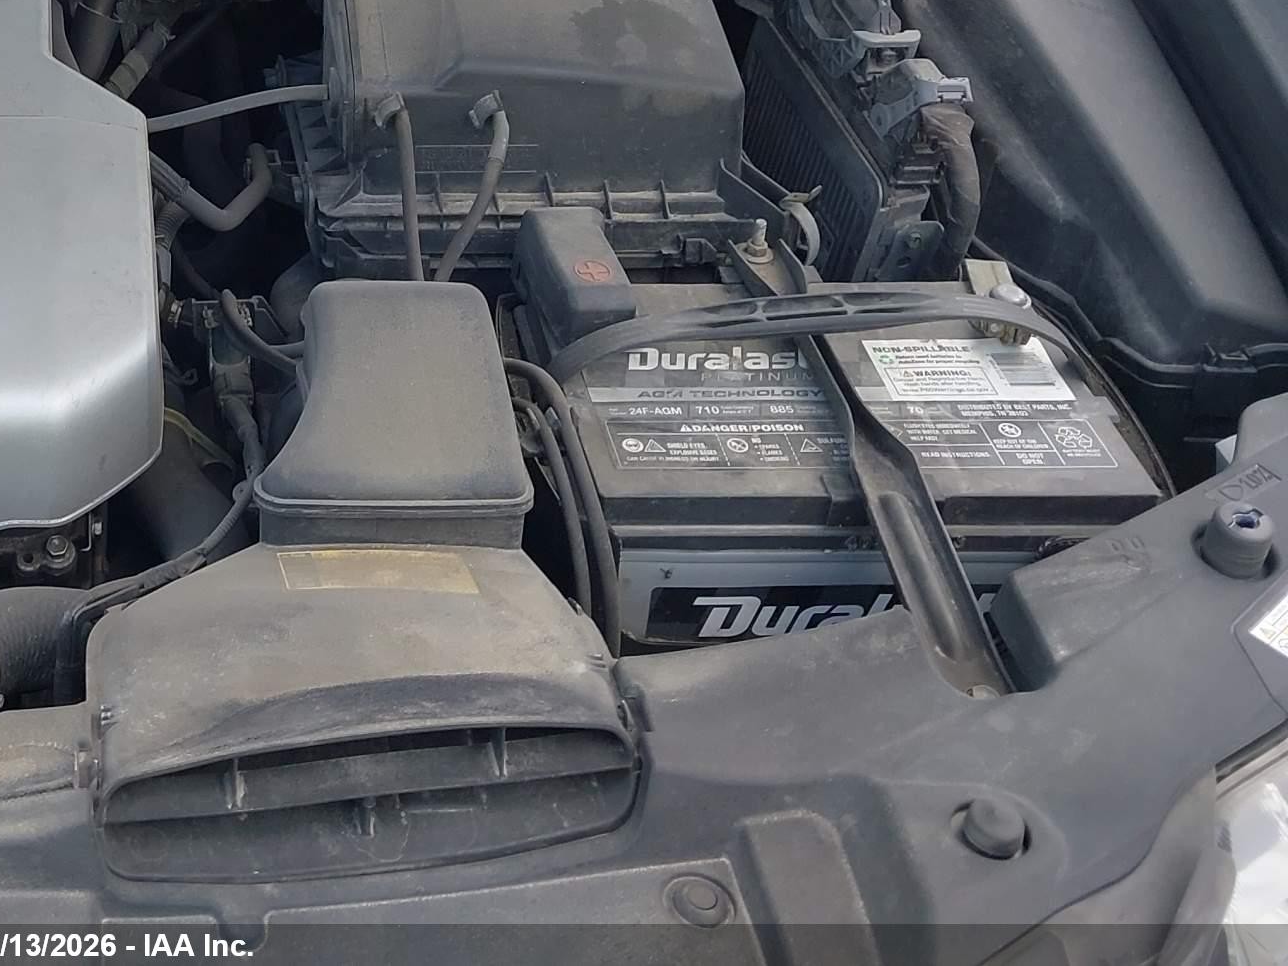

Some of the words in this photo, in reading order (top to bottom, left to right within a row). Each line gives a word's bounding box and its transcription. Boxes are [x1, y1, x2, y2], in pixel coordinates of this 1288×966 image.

[872, 345, 970, 353] NON-SPILLABLE
[689, 389, 823, 398] TECHNOLOGY
[695, 405, 720, 415] 710
[770, 405, 794, 414] 885
[692, 423, 805, 432] DANGER/POISON
[693, 593, 997, 638] Dural
